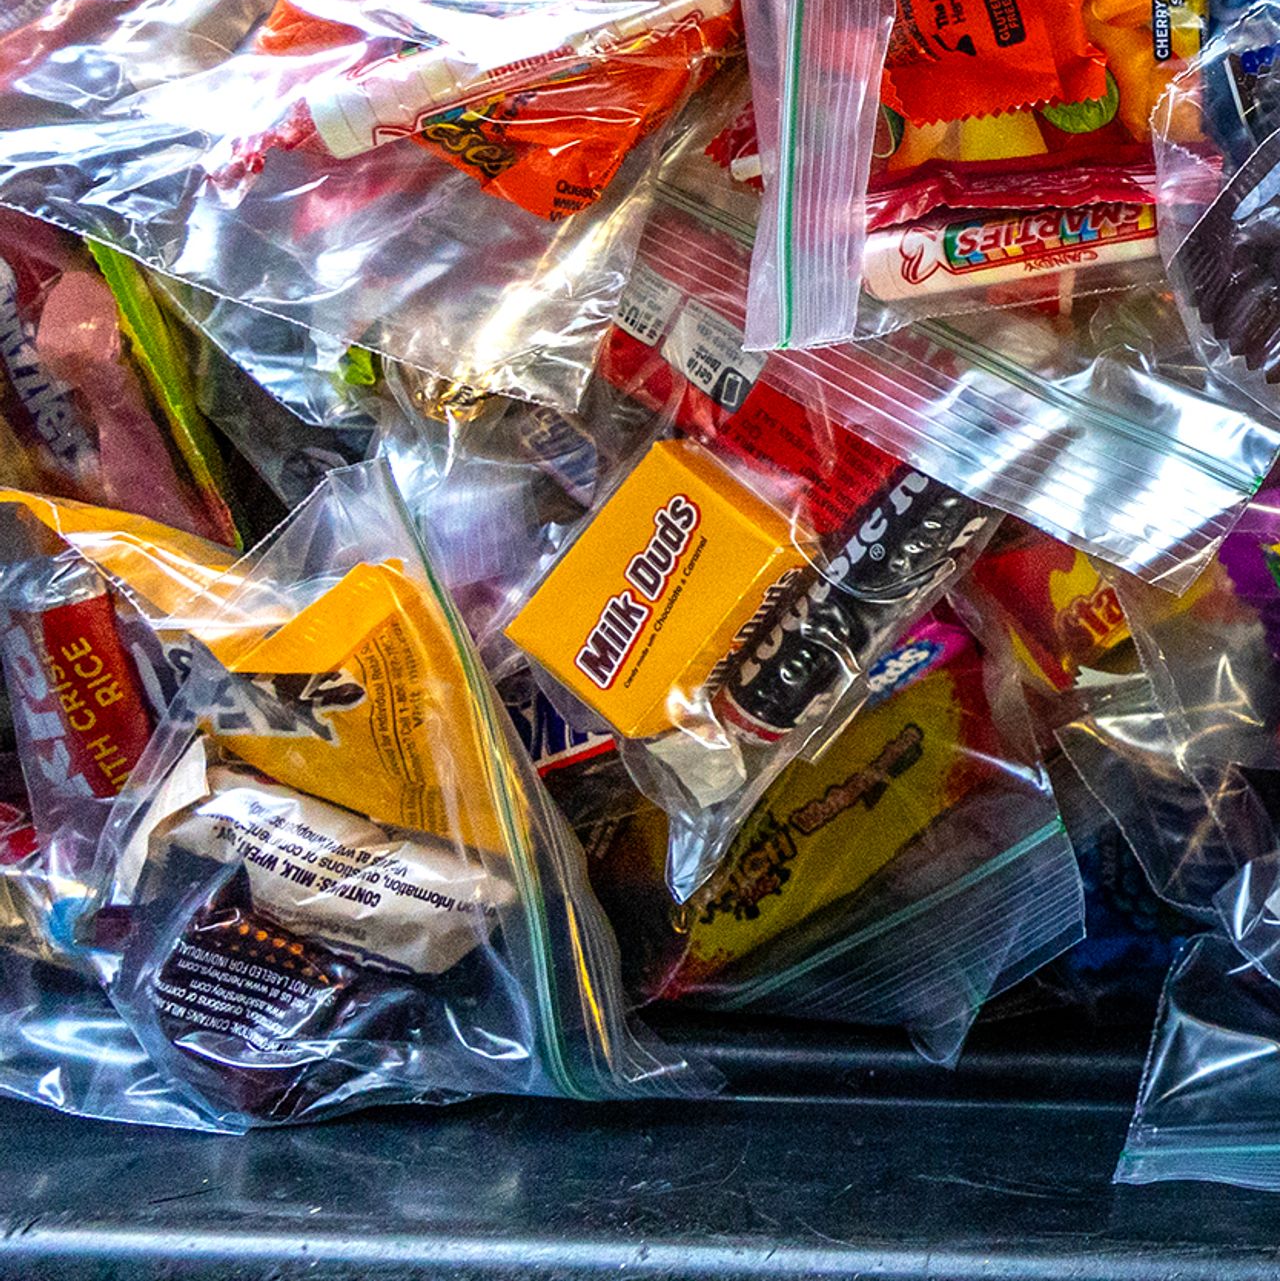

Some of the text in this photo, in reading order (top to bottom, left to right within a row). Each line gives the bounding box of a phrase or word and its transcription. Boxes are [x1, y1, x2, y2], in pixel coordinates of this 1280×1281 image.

[576, 493, 701, 689] Milk Duds
[652, 584, 685, 633] Chocolate
[683, 535, 709, 576] Caramel
[61, 637, 124, 706] RICE
